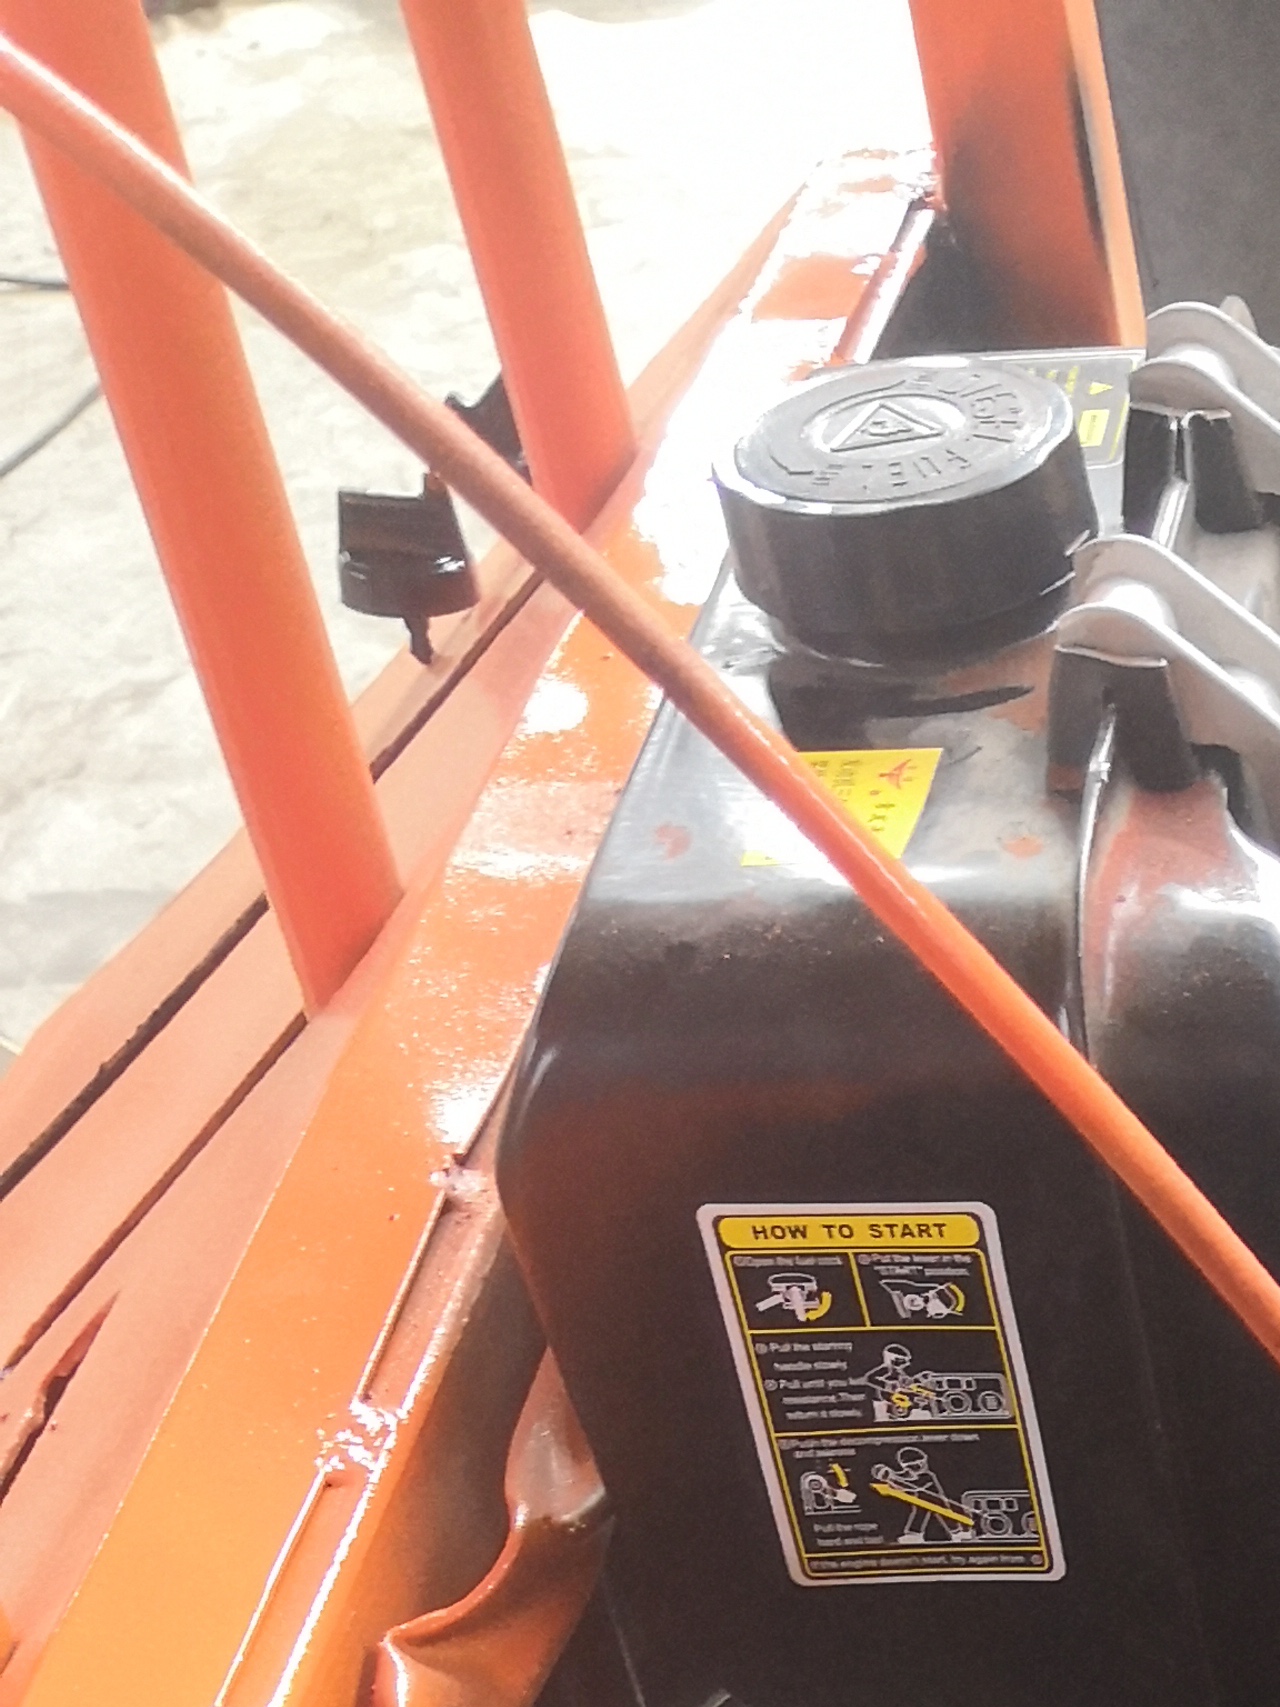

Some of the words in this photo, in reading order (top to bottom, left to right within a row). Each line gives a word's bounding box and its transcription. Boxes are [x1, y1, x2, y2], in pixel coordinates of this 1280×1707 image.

[752, 1224, 808, 1241] HOW
[826, 1223, 855, 1240] TO
[869, 1222, 948, 1239] START
